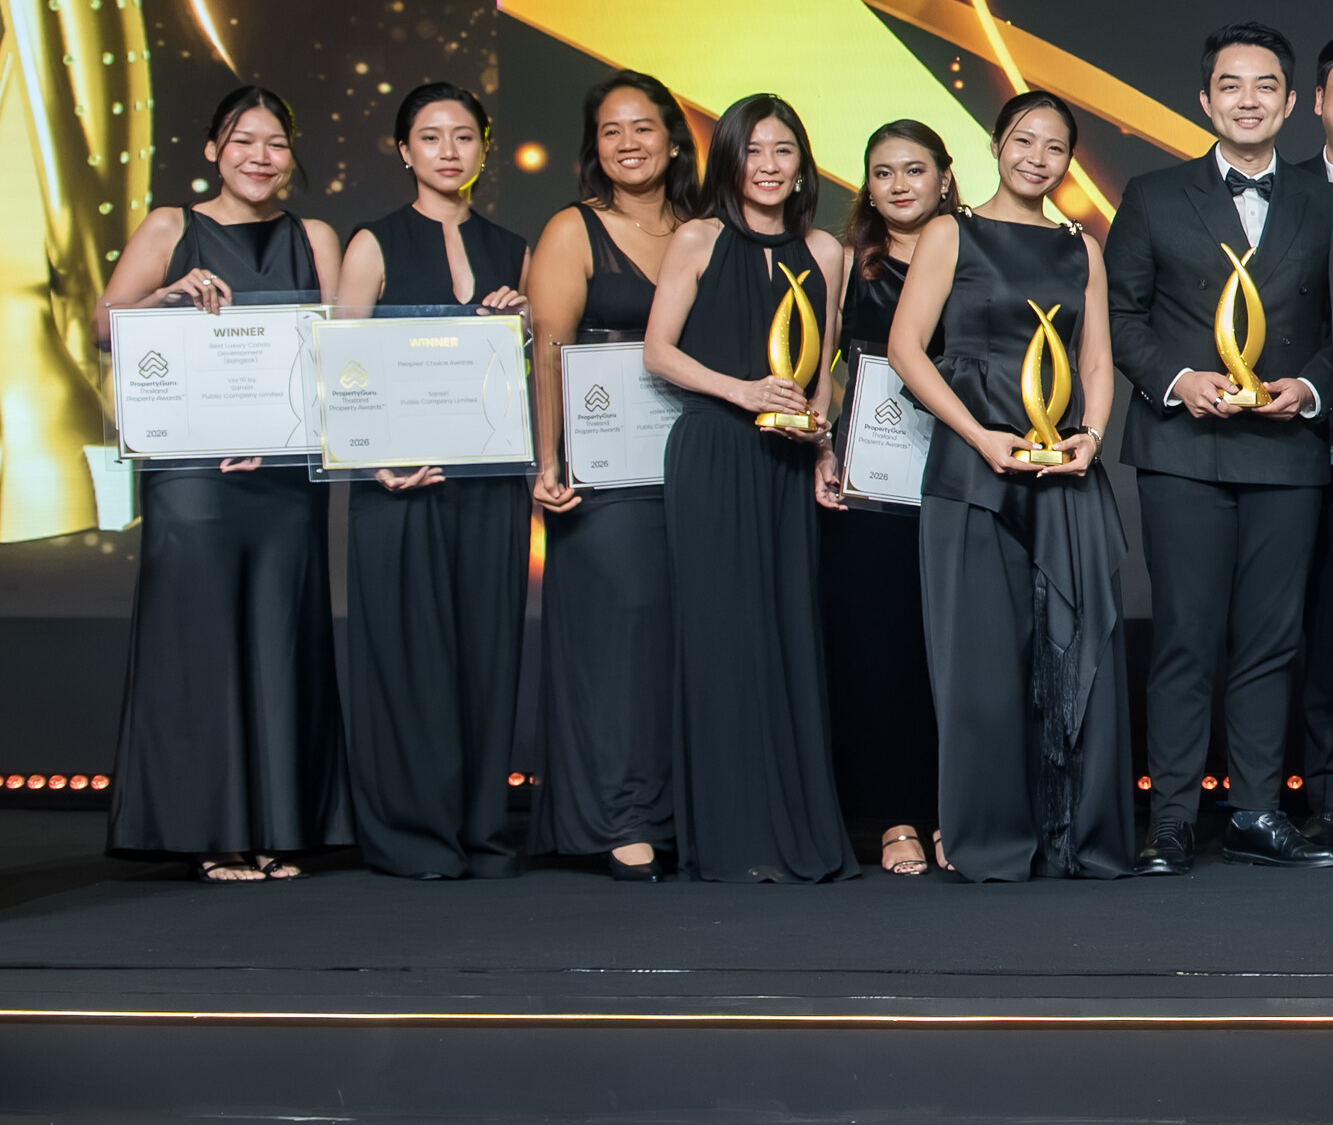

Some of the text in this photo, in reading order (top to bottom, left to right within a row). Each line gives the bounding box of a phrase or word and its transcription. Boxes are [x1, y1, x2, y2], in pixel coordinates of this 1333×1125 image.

[213, 327, 265, 337] WINNER
[408, 337, 459, 347] WINNER
[146, 429, 168, 437] 2026
[349, 439, 370, 447] 2026
[590, 459, 608, 469] 2026
[869, 471, 888, 481] 2026
